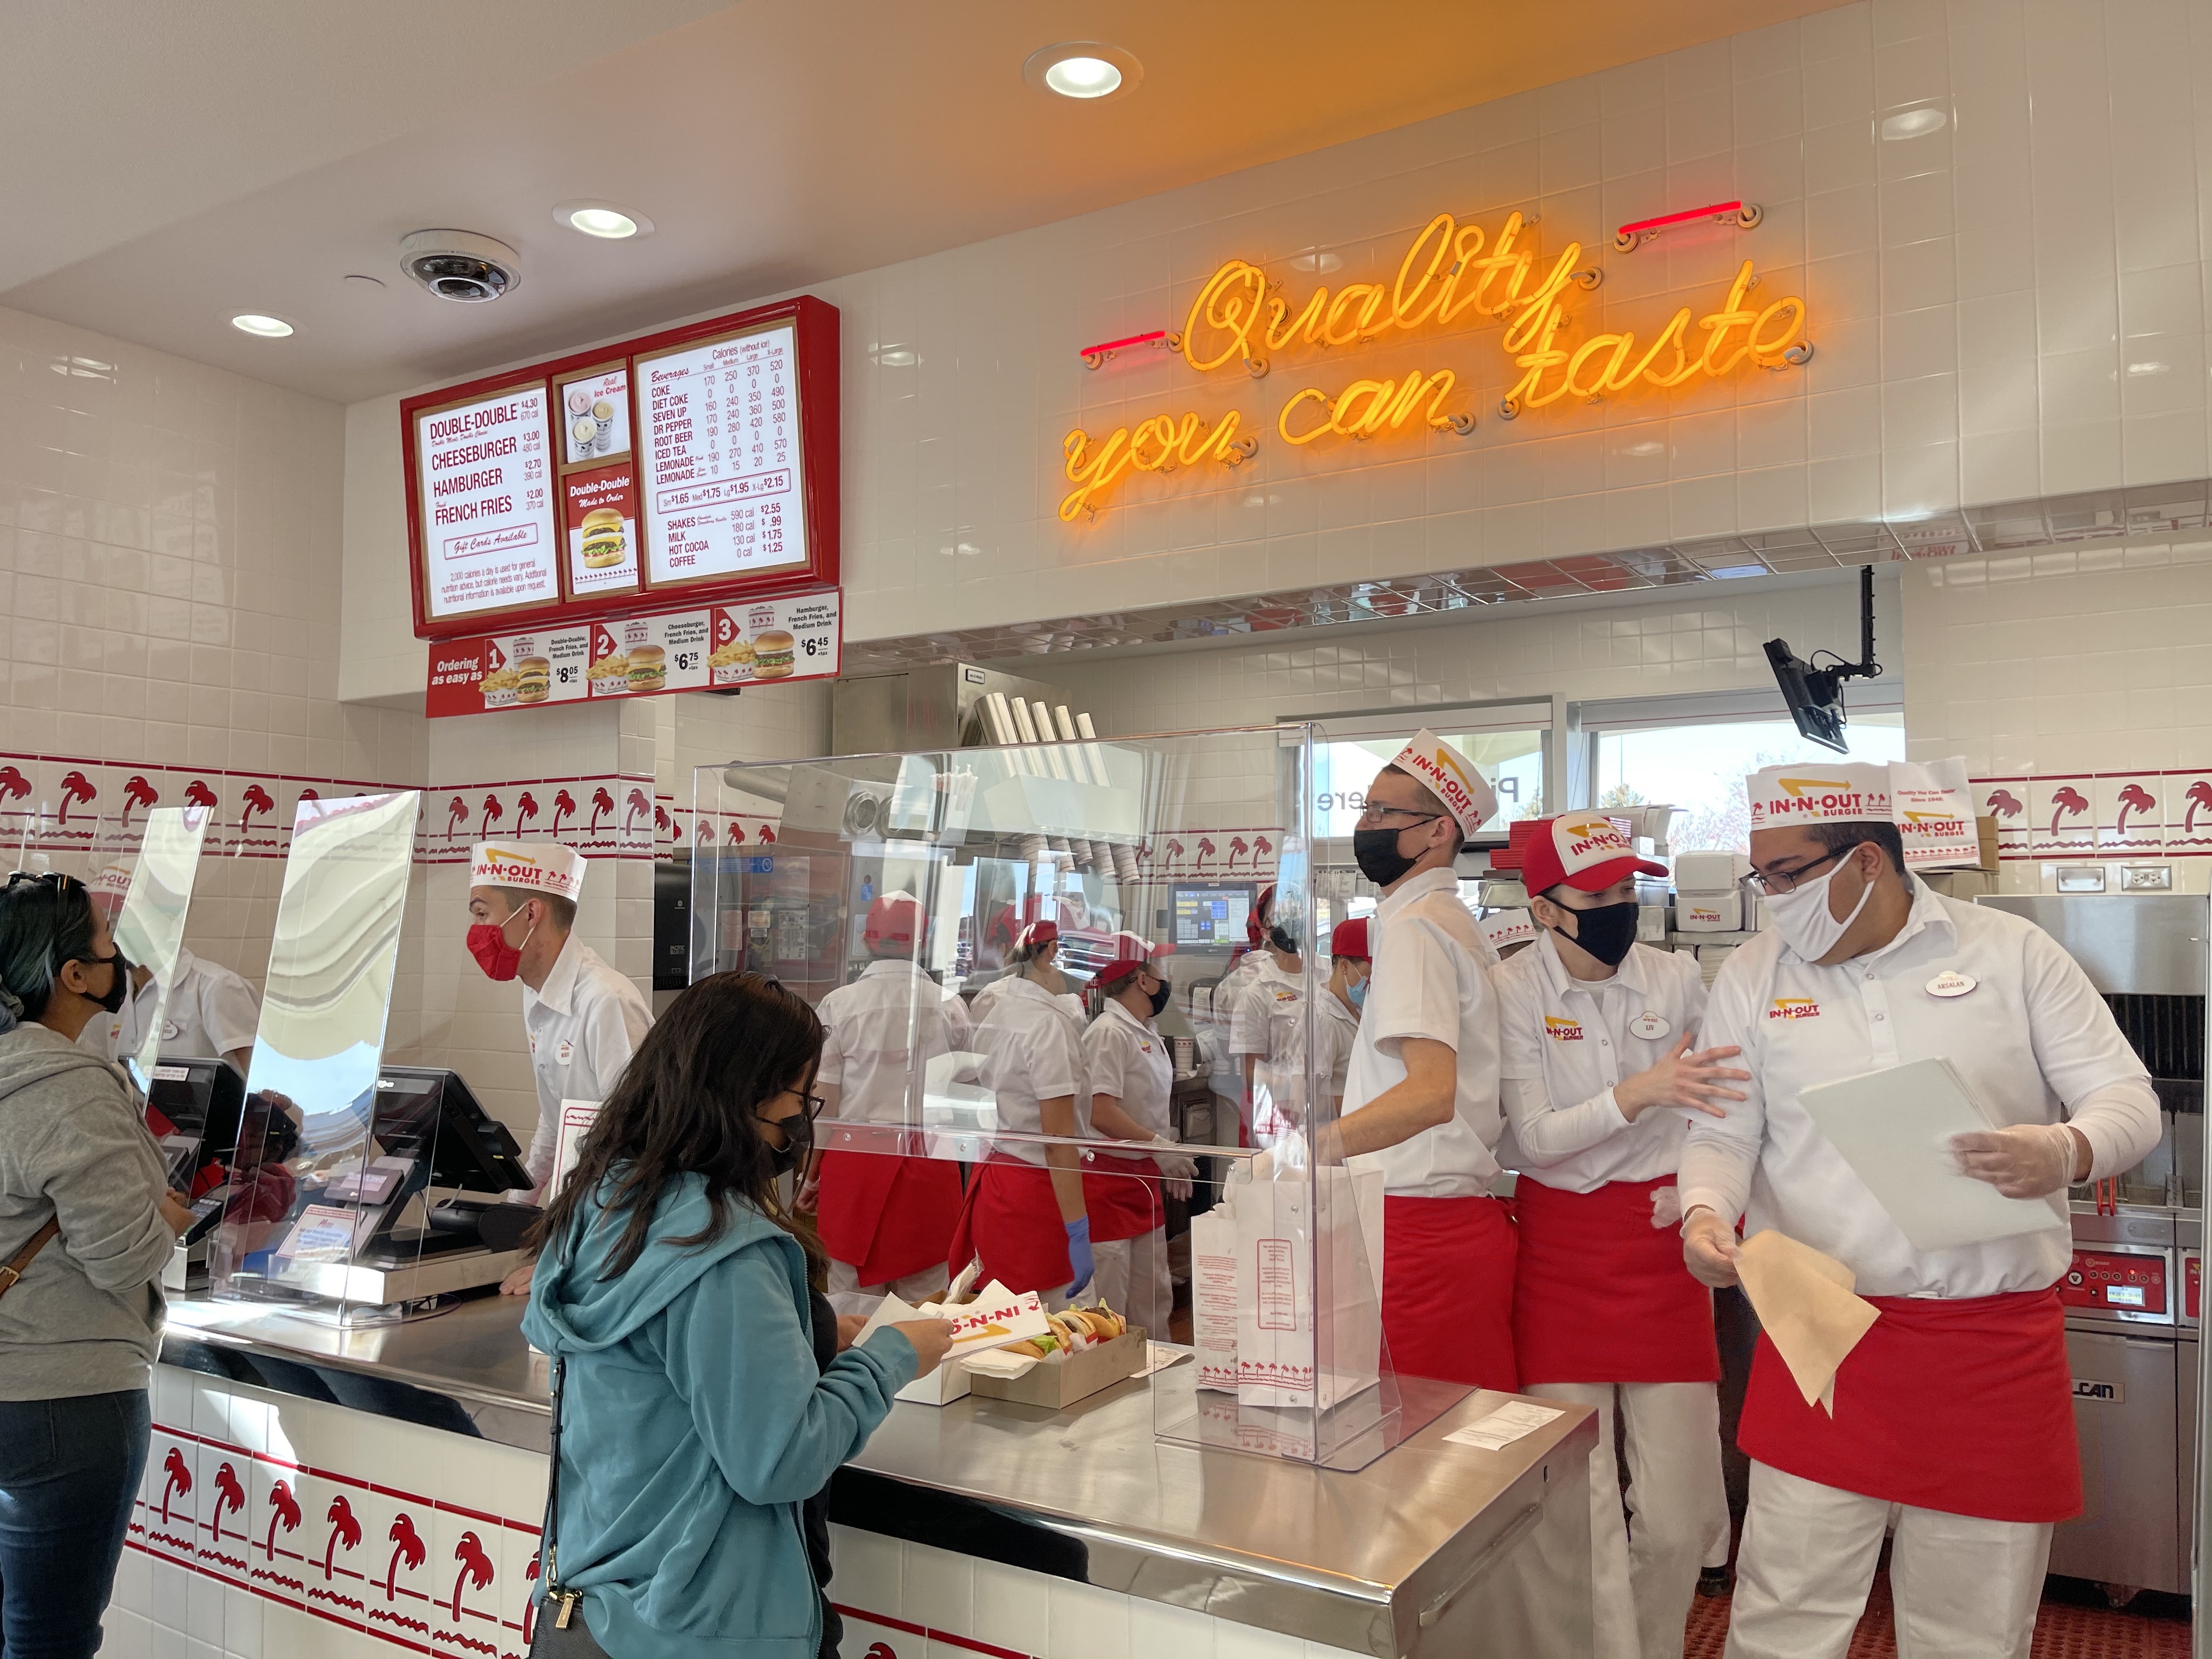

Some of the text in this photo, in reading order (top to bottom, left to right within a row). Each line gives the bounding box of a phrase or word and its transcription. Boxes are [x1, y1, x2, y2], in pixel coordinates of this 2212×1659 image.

[1183, 212, 1581, 371] Quality
[713, 340, 770, 360] Calories (without ice)
[651, 366, 690, 383] Beverages
[652, 359, 782, 398] COKE 170 250 370 520
[606, 385, 626, 394] Cream
[1059, 259, 1806, 521] you can taste
[653, 393, 688, 410] DIET COKE
[653, 386, 784, 422] SEVEN UP 160 240 350 490
[430, 398, 538, 439] DOUBLE-DOUBLE $4.30
[521, 410, 530, 421] 670
[654, 399, 785, 435] DR PEPPER 170 240 360 500
[654, 412, 786, 447] ROOT BEER 190 280 420 580
[432, 431, 539, 470] CHEESEBURGER $3.00
[523, 443, 532, 452] 480
[656, 445, 686, 460] ICED TEA
[656, 438, 787, 472] LEMONADE 190 270 410 570
[433, 459, 541, 498] HAMBURGER $2.70
[524, 471, 534, 481] 390
[657, 452, 786, 484] LEMONADE 10 15 20 25
[570, 476, 629, 497] Double-Double
[672, 476, 783, 504] $1.65 $1.75 $1.95 $2.15
[436, 488, 543, 526] FRENCH FRIES $2.00
[526, 500, 535, 511] 370
[579, 498, 597, 507] Made
[606, 493, 623, 503] Order
[668, 503, 780, 531] SHAKES 590 cal $2.55
[454, 529, 527, 554] Gift Cards Available
[669, 521, 754, 543] MILK 180 cal
[669, 534, 755, 555] HOT COCOA 130 cal
[670, 547, 752, 567] COFFEE cal
[465, 559, 535, 579] calories used general
[483, 576, 498, 586] calorie
[525, 568, 546, 579] Additional
[668, 622, 705, 630] Cheeseburger,
[718, 617, 731, 640] 3
[597, 634, 609, 655] 2
[437, 657, 479, 672] Ordering
[489, 647, 501, 669] 1
[432, 671, 482, 685] as easy as
[1413, 755, 1472, 809] IN-N-OUT
[1441, 788, 1463, 815] BURGER
[1770, 794, 1861, 815] IN-N-OUT
[1824, 808, 1863, 816] BURGER
[1897, 821, 1964, 833] IN-N-OUT
[477, 864, 543, 879] IN-N-OUT
[507, 877, 540, 885] BURGER
[1770, 1005, 1819, 1019] IN-N-OUT
